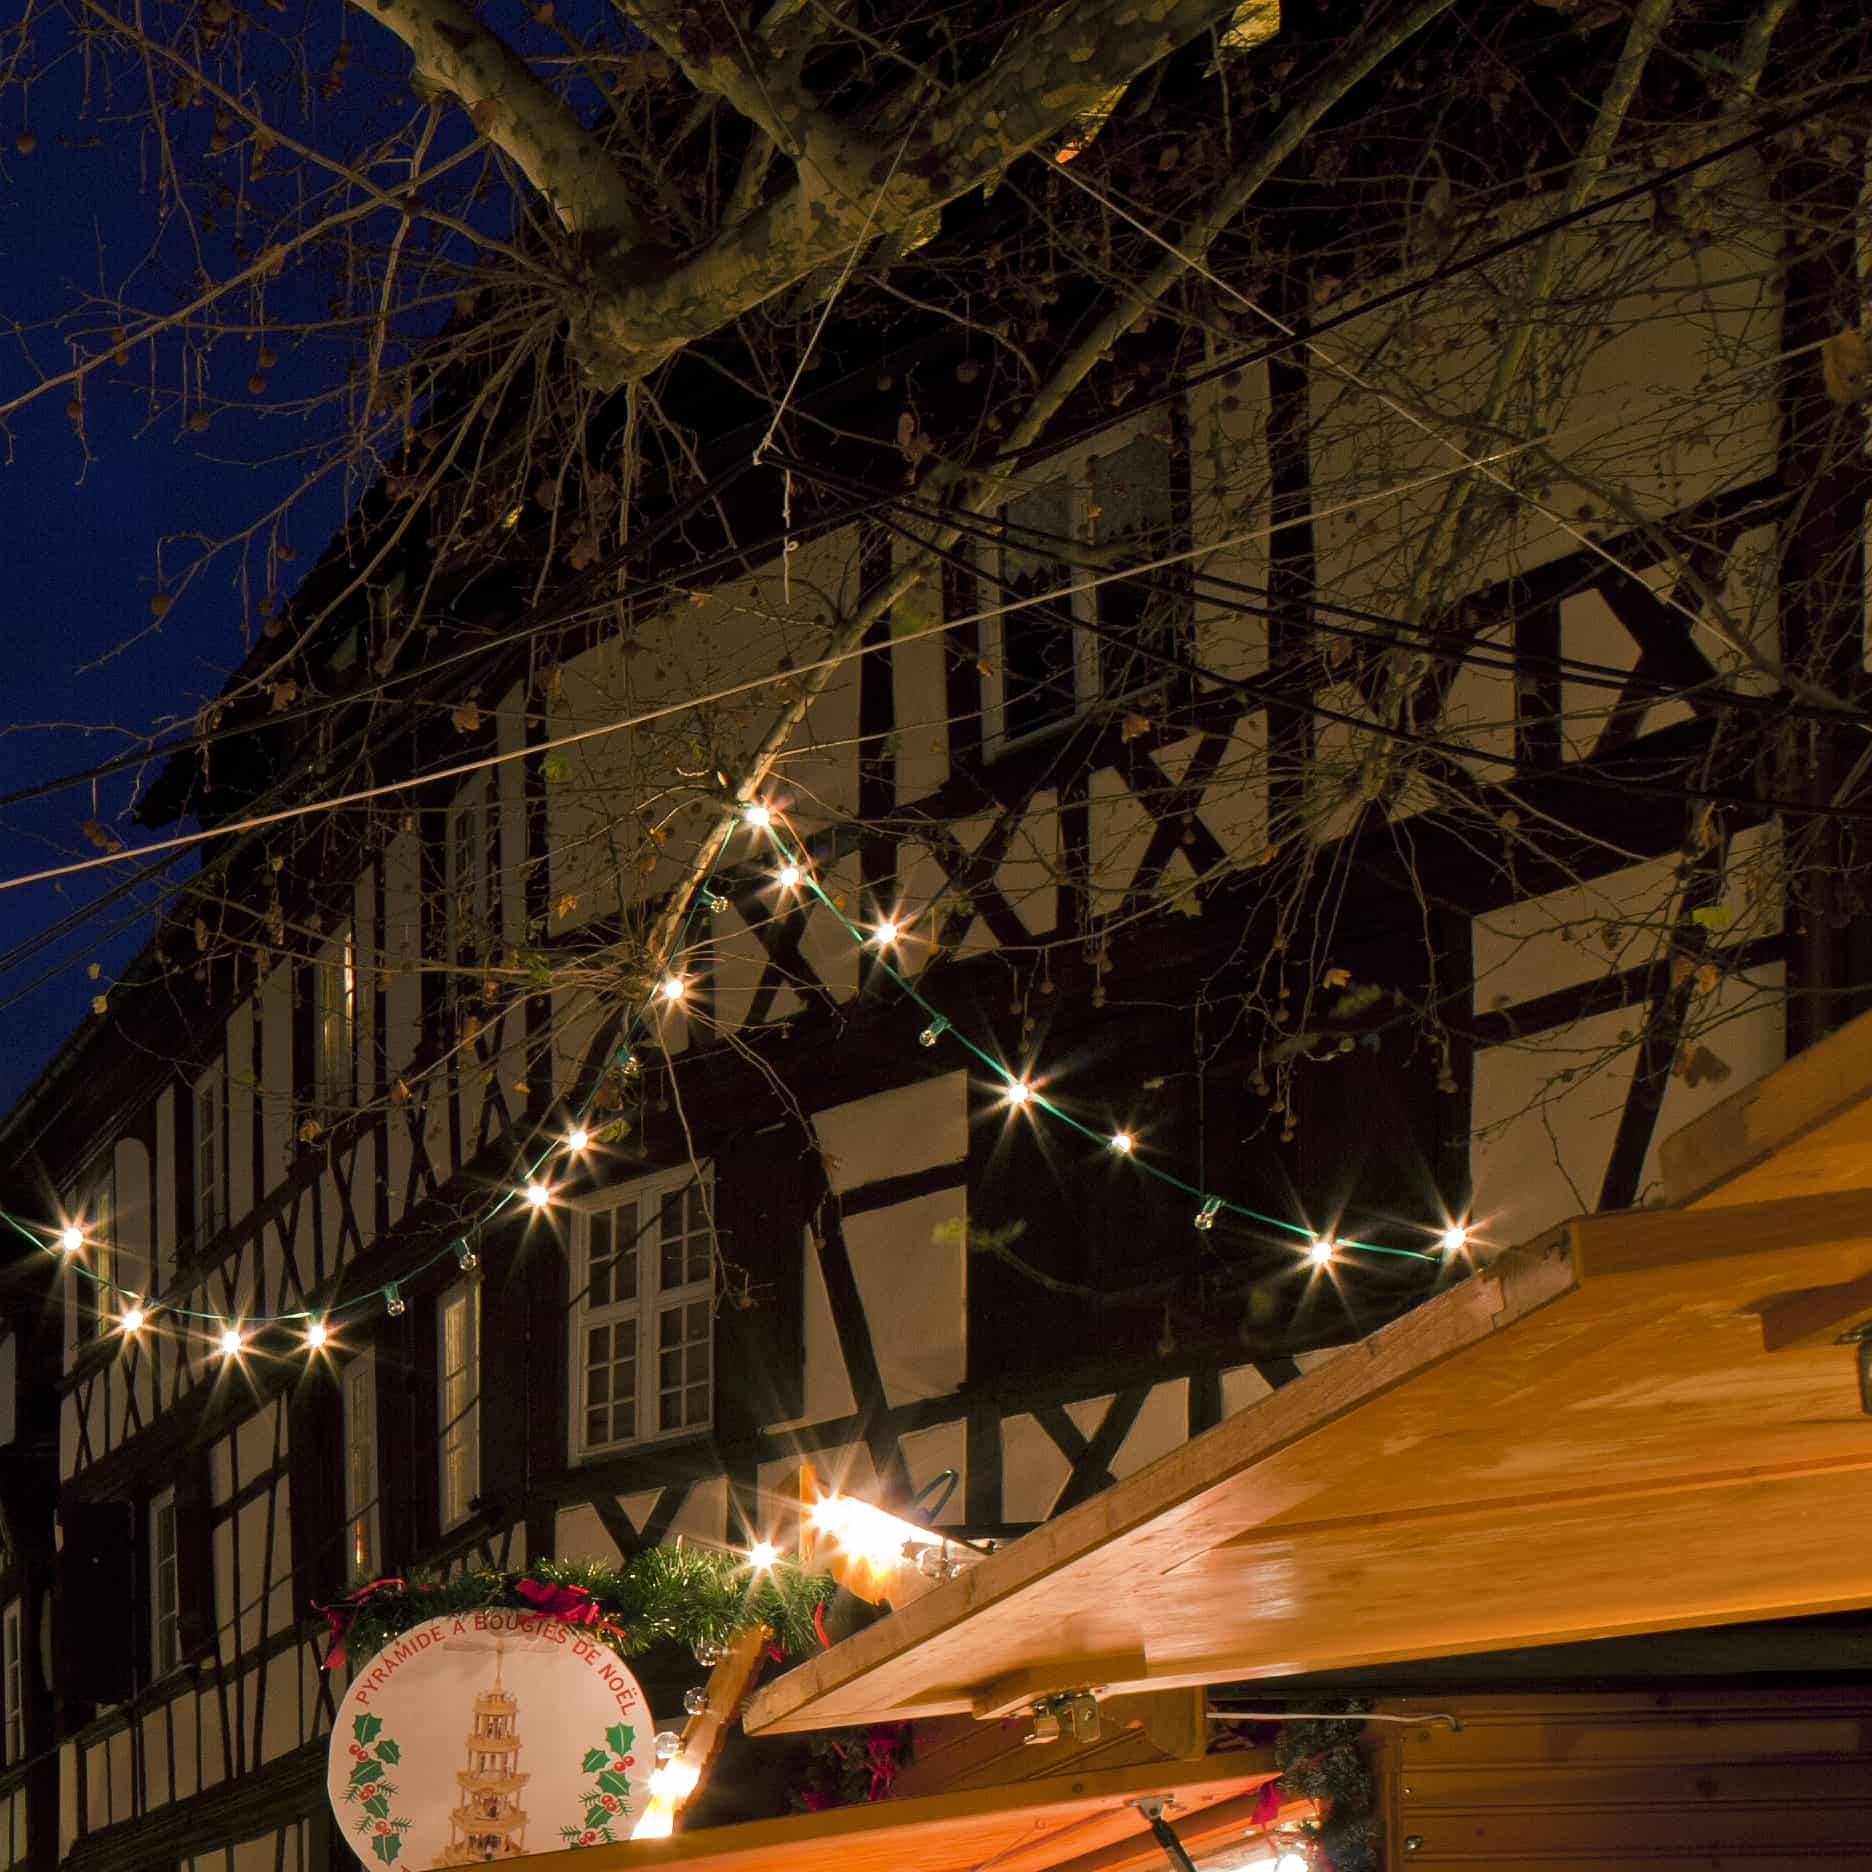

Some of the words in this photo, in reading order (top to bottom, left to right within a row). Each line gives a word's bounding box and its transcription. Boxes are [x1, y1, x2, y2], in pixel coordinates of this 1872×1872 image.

[355, 1625, 446, 1705] PYRAMIDE
[474, 1614, 570, 1645] BOUGIES
[572, 1639, 601, 1666] DE
[598, 1663, 638, 1716] NOËL
